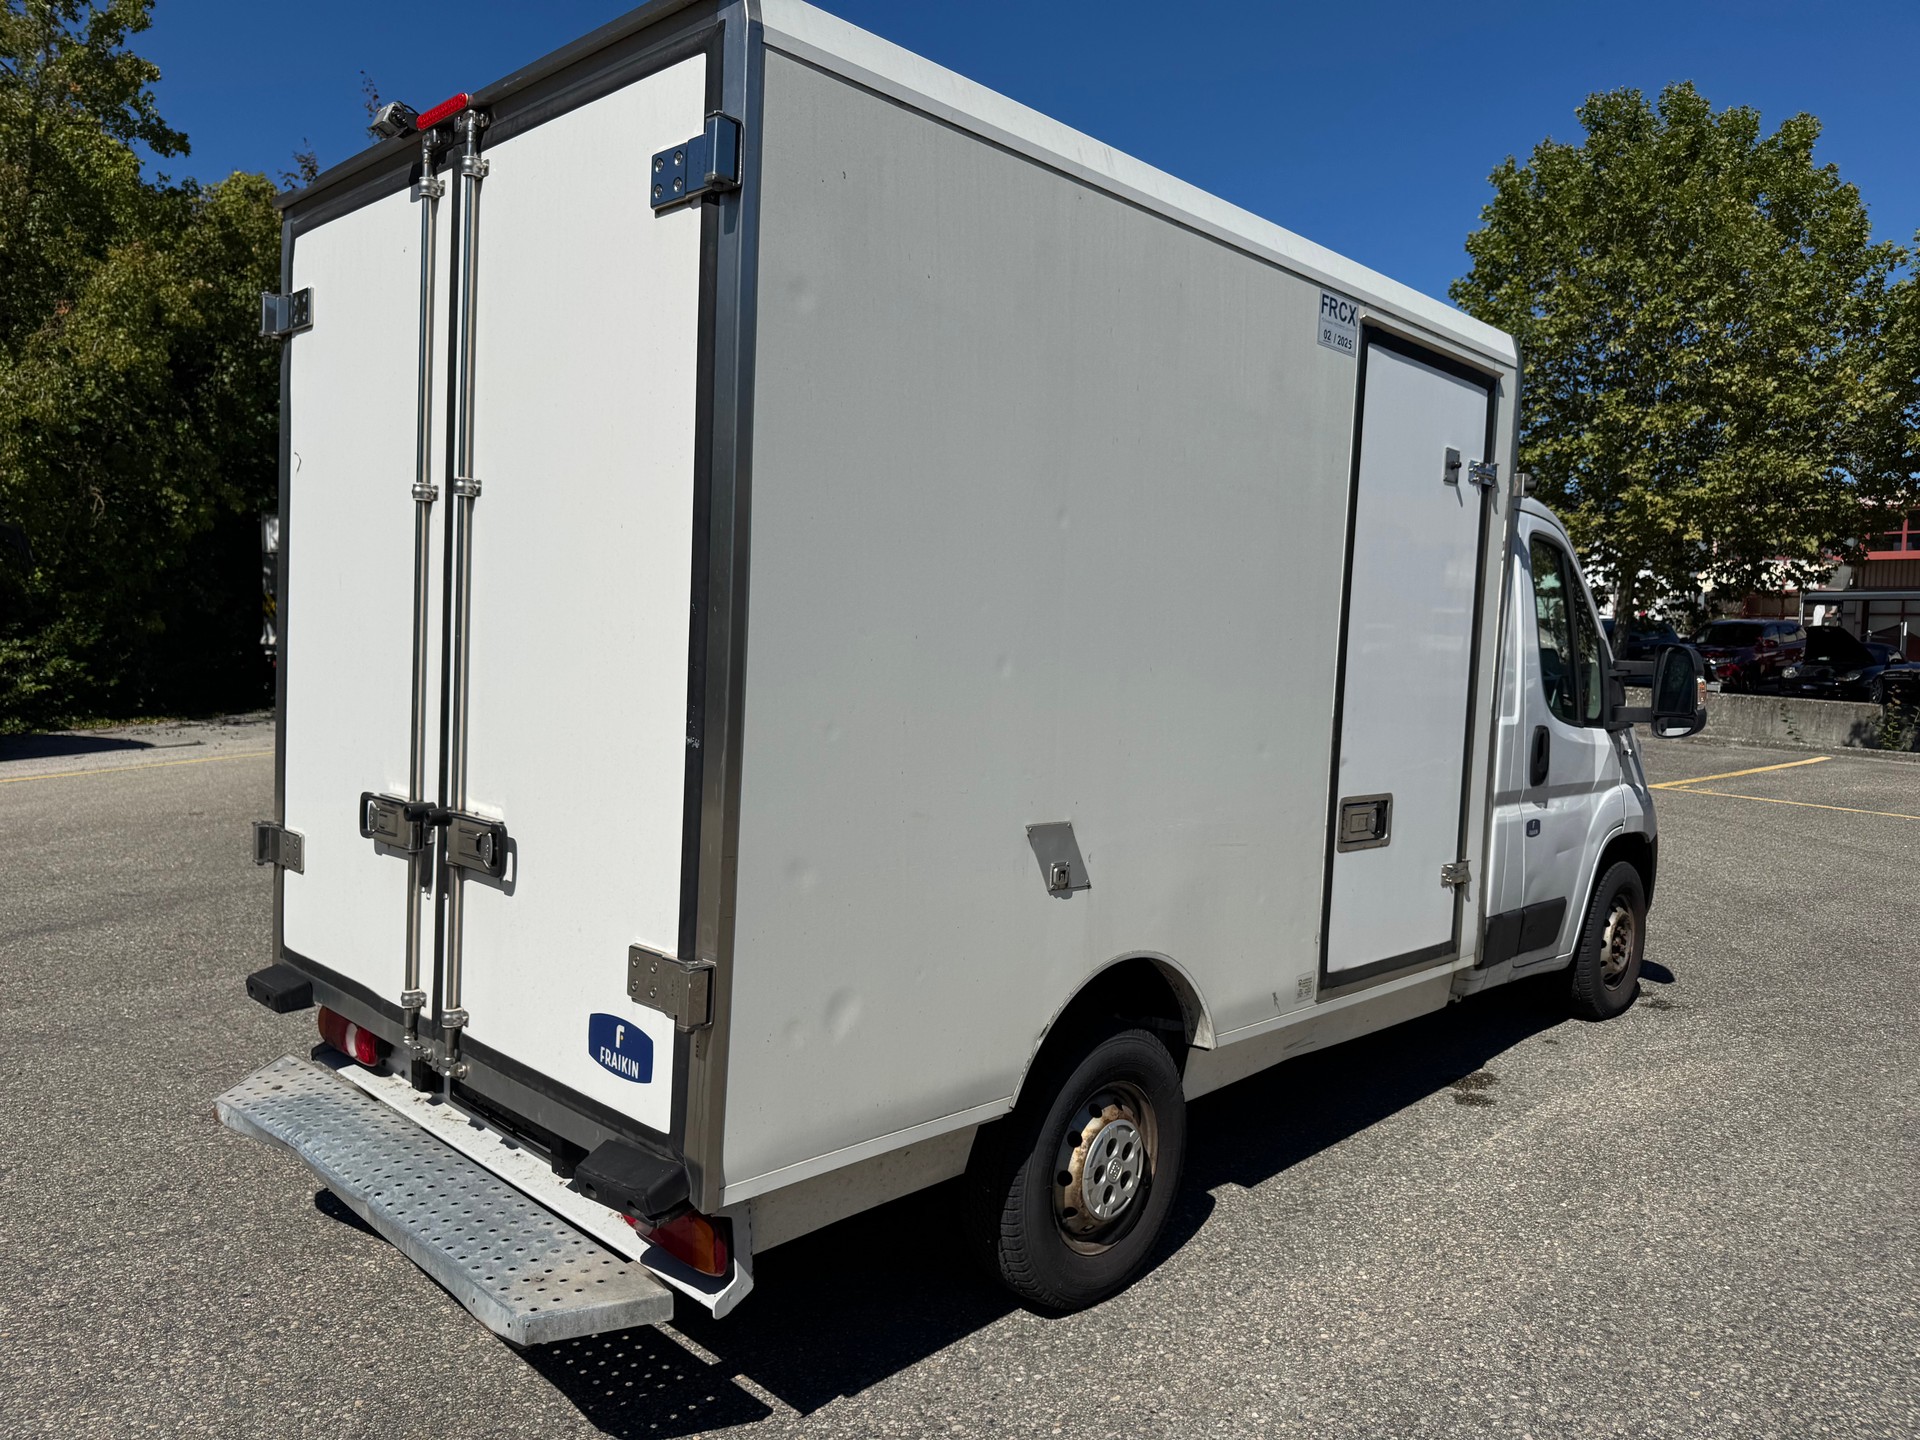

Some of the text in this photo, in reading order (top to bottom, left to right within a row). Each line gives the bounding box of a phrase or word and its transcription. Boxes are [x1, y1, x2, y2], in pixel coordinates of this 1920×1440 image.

[1321, 293, 1357, 327] FRCX
[1323, 329, 1332, 341] 02
[1337, 335, 1352, 350] 2025
[600, 1045, 639, 1080] FRAIKIN
